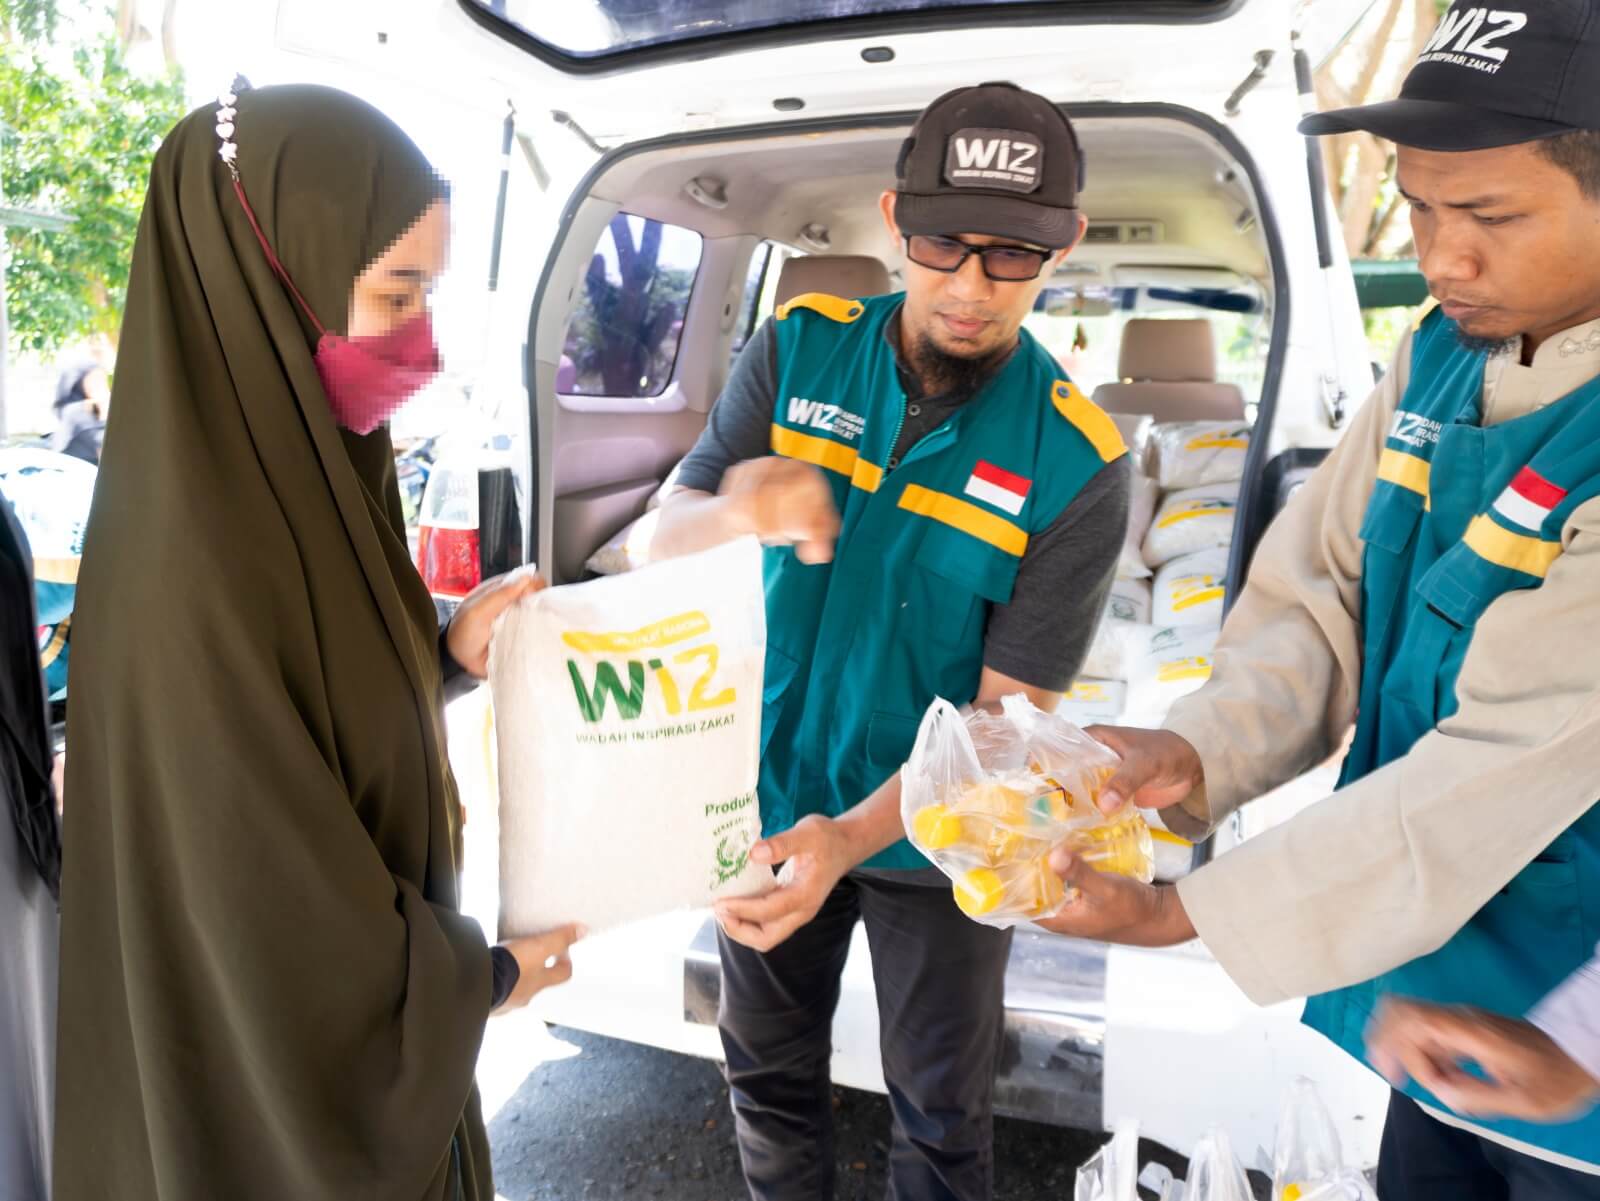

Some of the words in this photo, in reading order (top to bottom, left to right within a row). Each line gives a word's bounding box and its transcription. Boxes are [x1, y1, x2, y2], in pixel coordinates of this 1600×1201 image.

[1465, 58, 1501, 75] ZAKAT
[632, 722, 696, 741] INSPIRASI
[699, 713, 736, 732] ZAKAT
[704, 792, 754, 817] Produk
